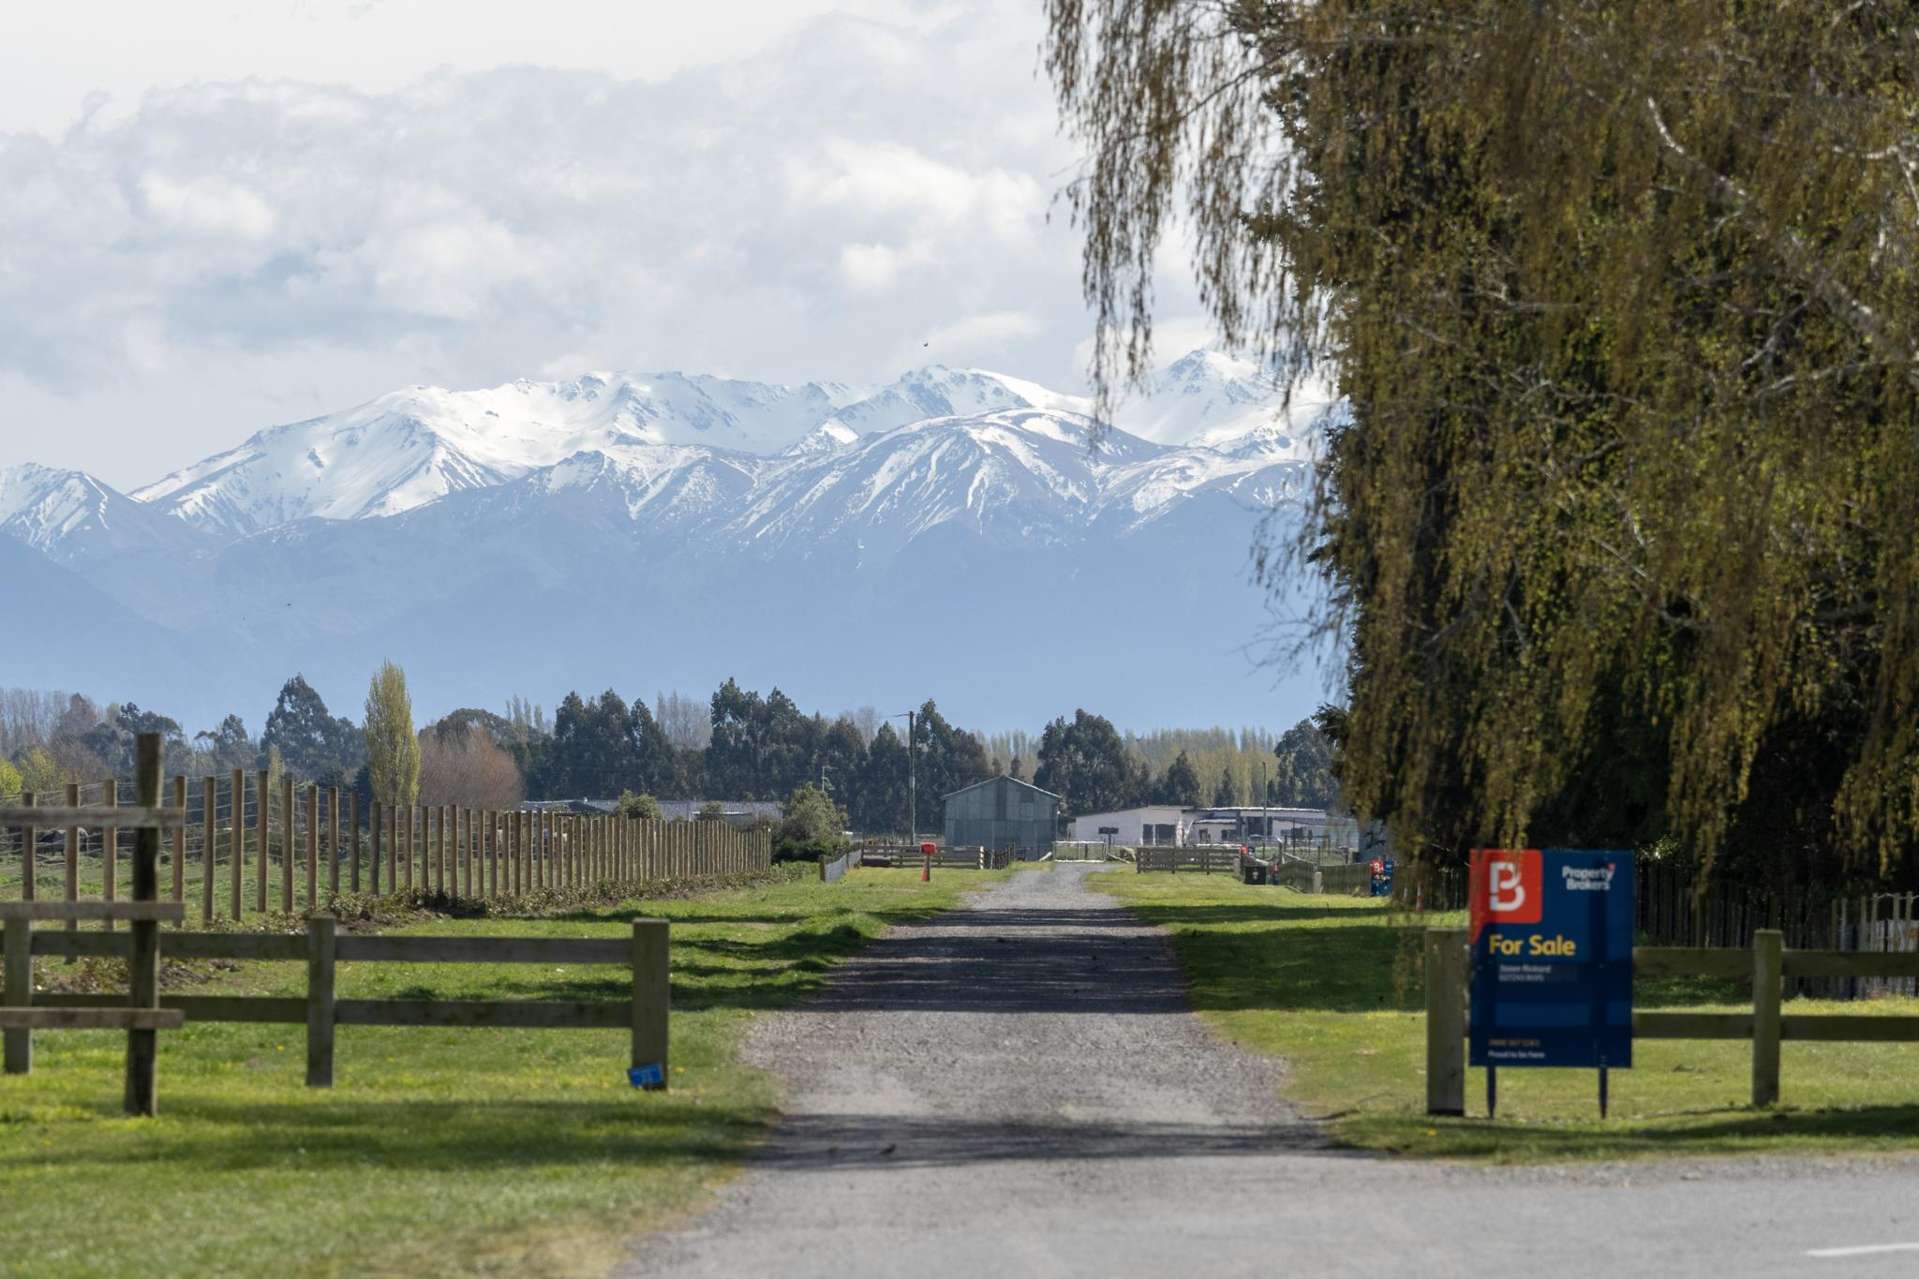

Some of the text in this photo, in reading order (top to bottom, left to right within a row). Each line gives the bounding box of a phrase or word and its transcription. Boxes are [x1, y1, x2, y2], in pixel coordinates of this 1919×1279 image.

[1562, 864, 1616, 881] Property
[1489, 861, 1526, 912] B
[1566, 878, 1610, 891] Brokers
[1489, 934, 1577, 956] For Sale
